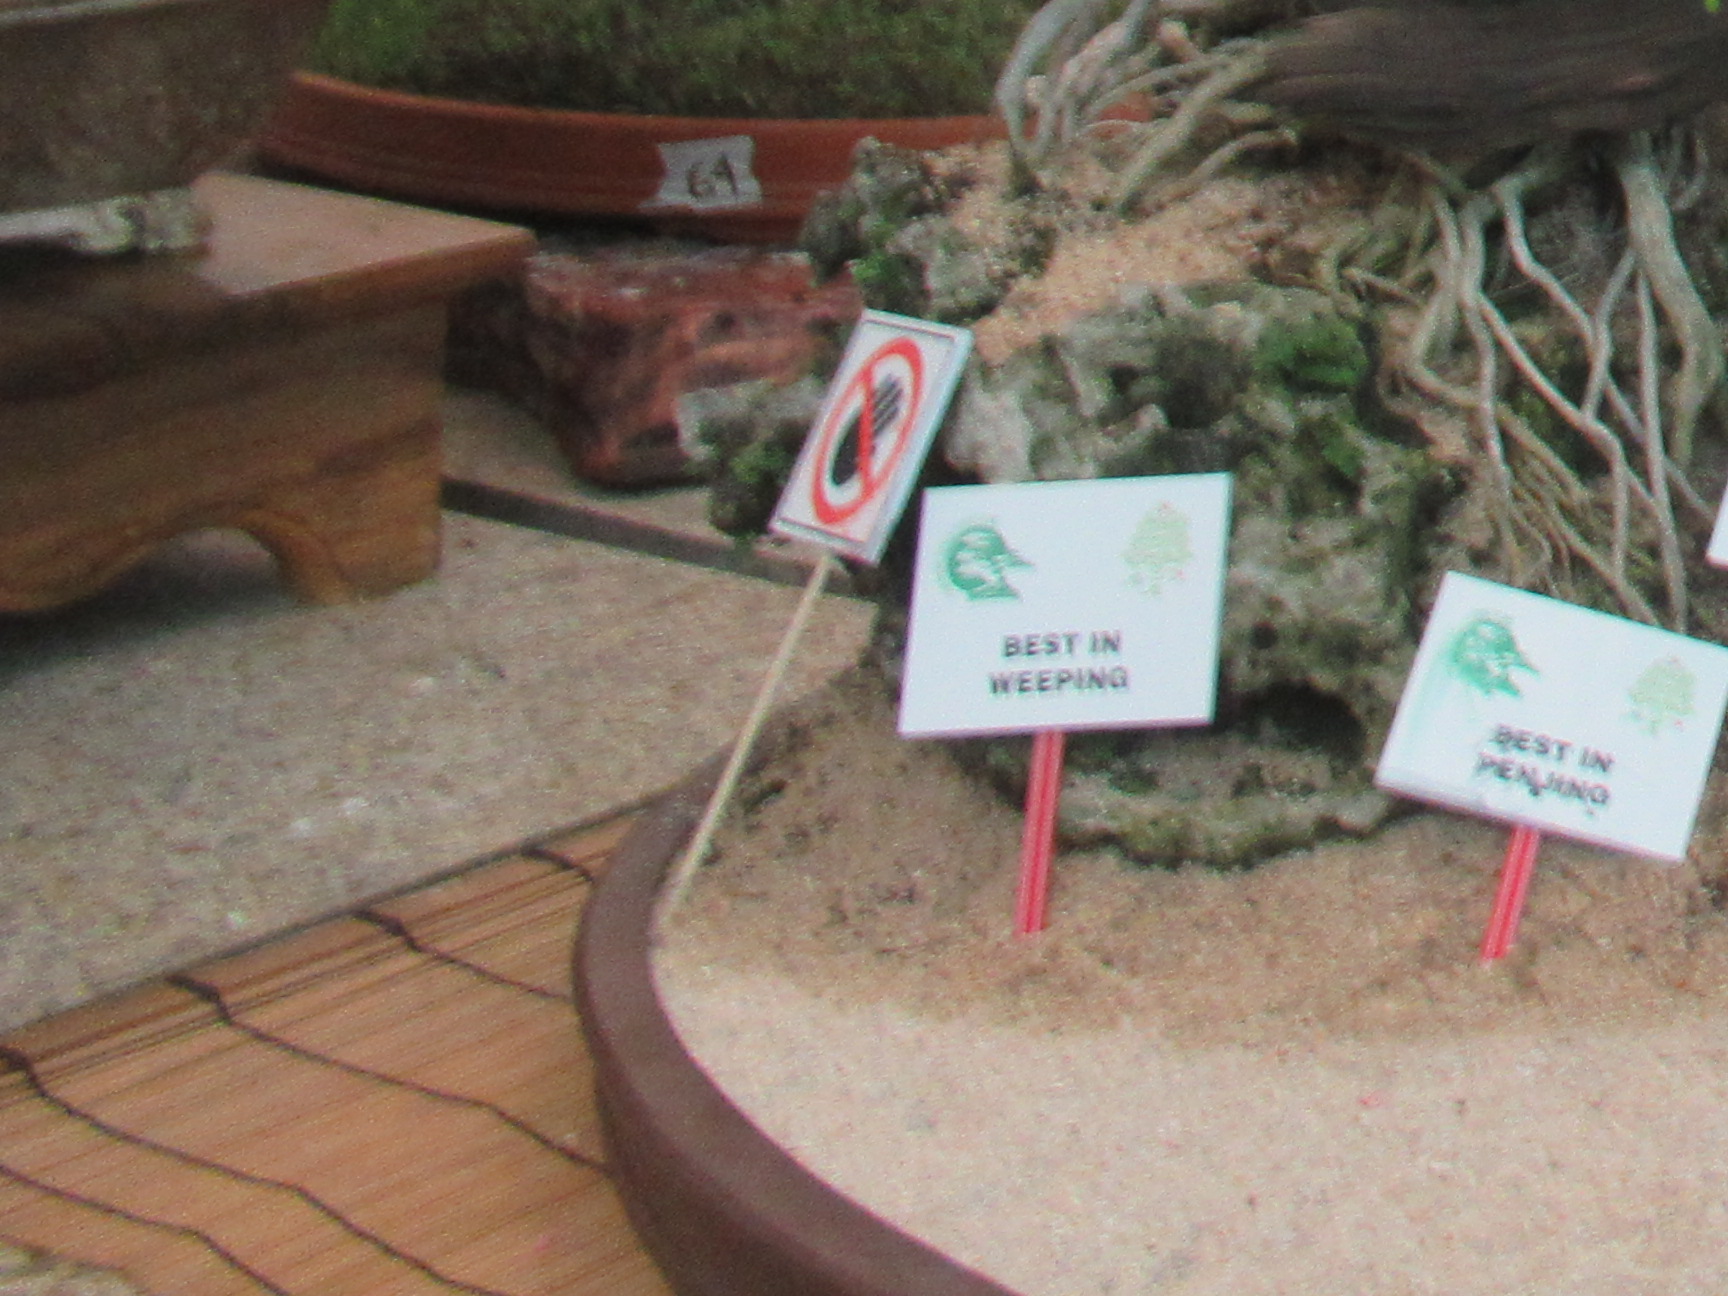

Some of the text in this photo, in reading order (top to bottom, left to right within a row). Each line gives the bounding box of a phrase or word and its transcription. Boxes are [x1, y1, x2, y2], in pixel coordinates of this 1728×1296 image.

[1003, 629, 1122, 658] BEST IN
[989, 665, 1129, 695] WEEPING
[1493, 724, 1615, 773] BEST IN
